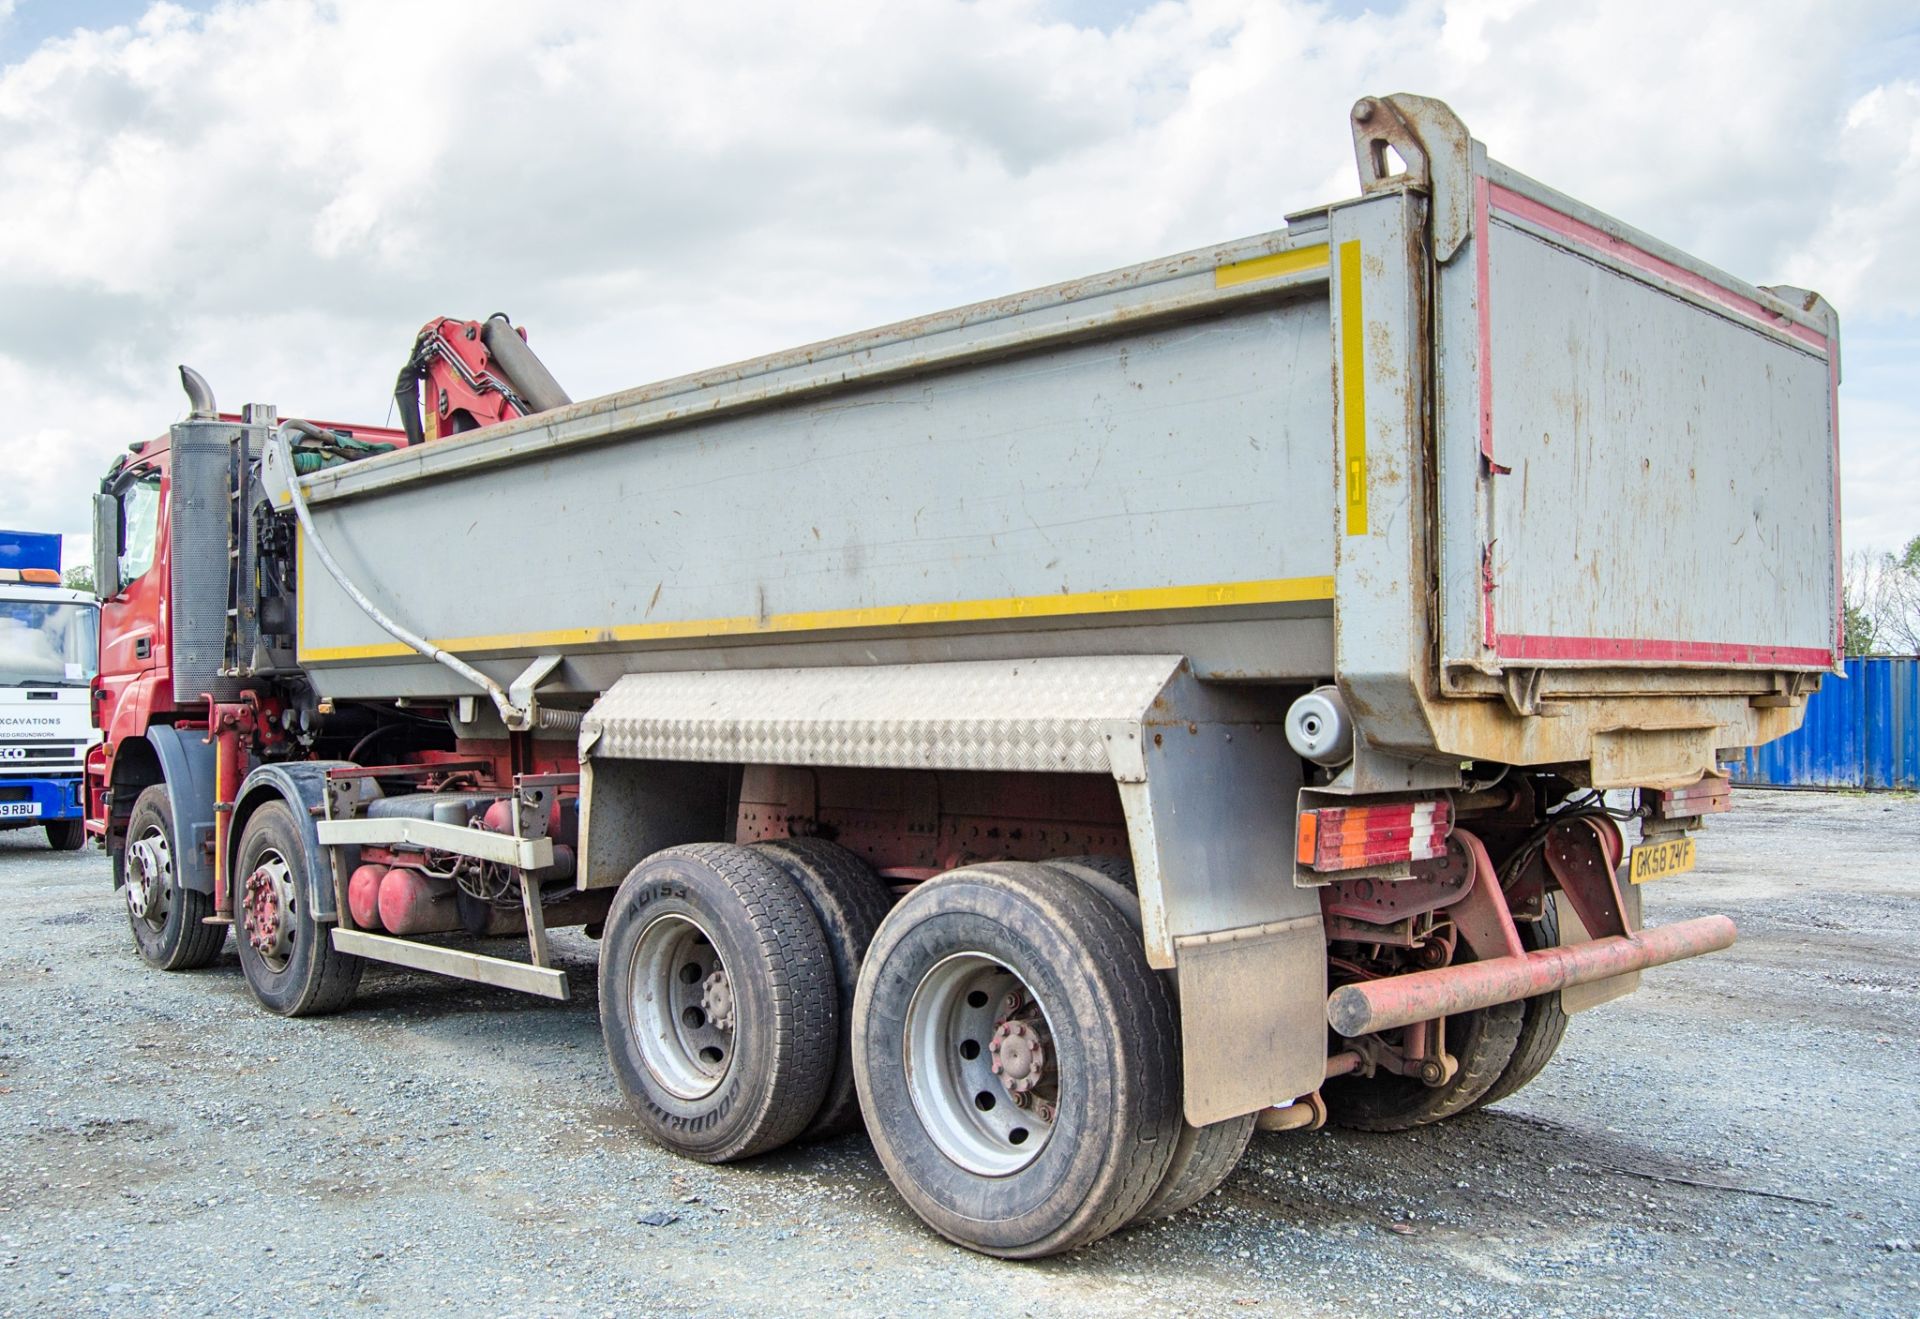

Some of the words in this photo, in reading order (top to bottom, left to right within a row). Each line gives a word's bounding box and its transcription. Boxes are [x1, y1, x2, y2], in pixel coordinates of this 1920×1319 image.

[12, 804, 34, 815] RBU
[1636, 846, 1666, 877] GK58
[1669, 840, 1691, 870] ZYF
